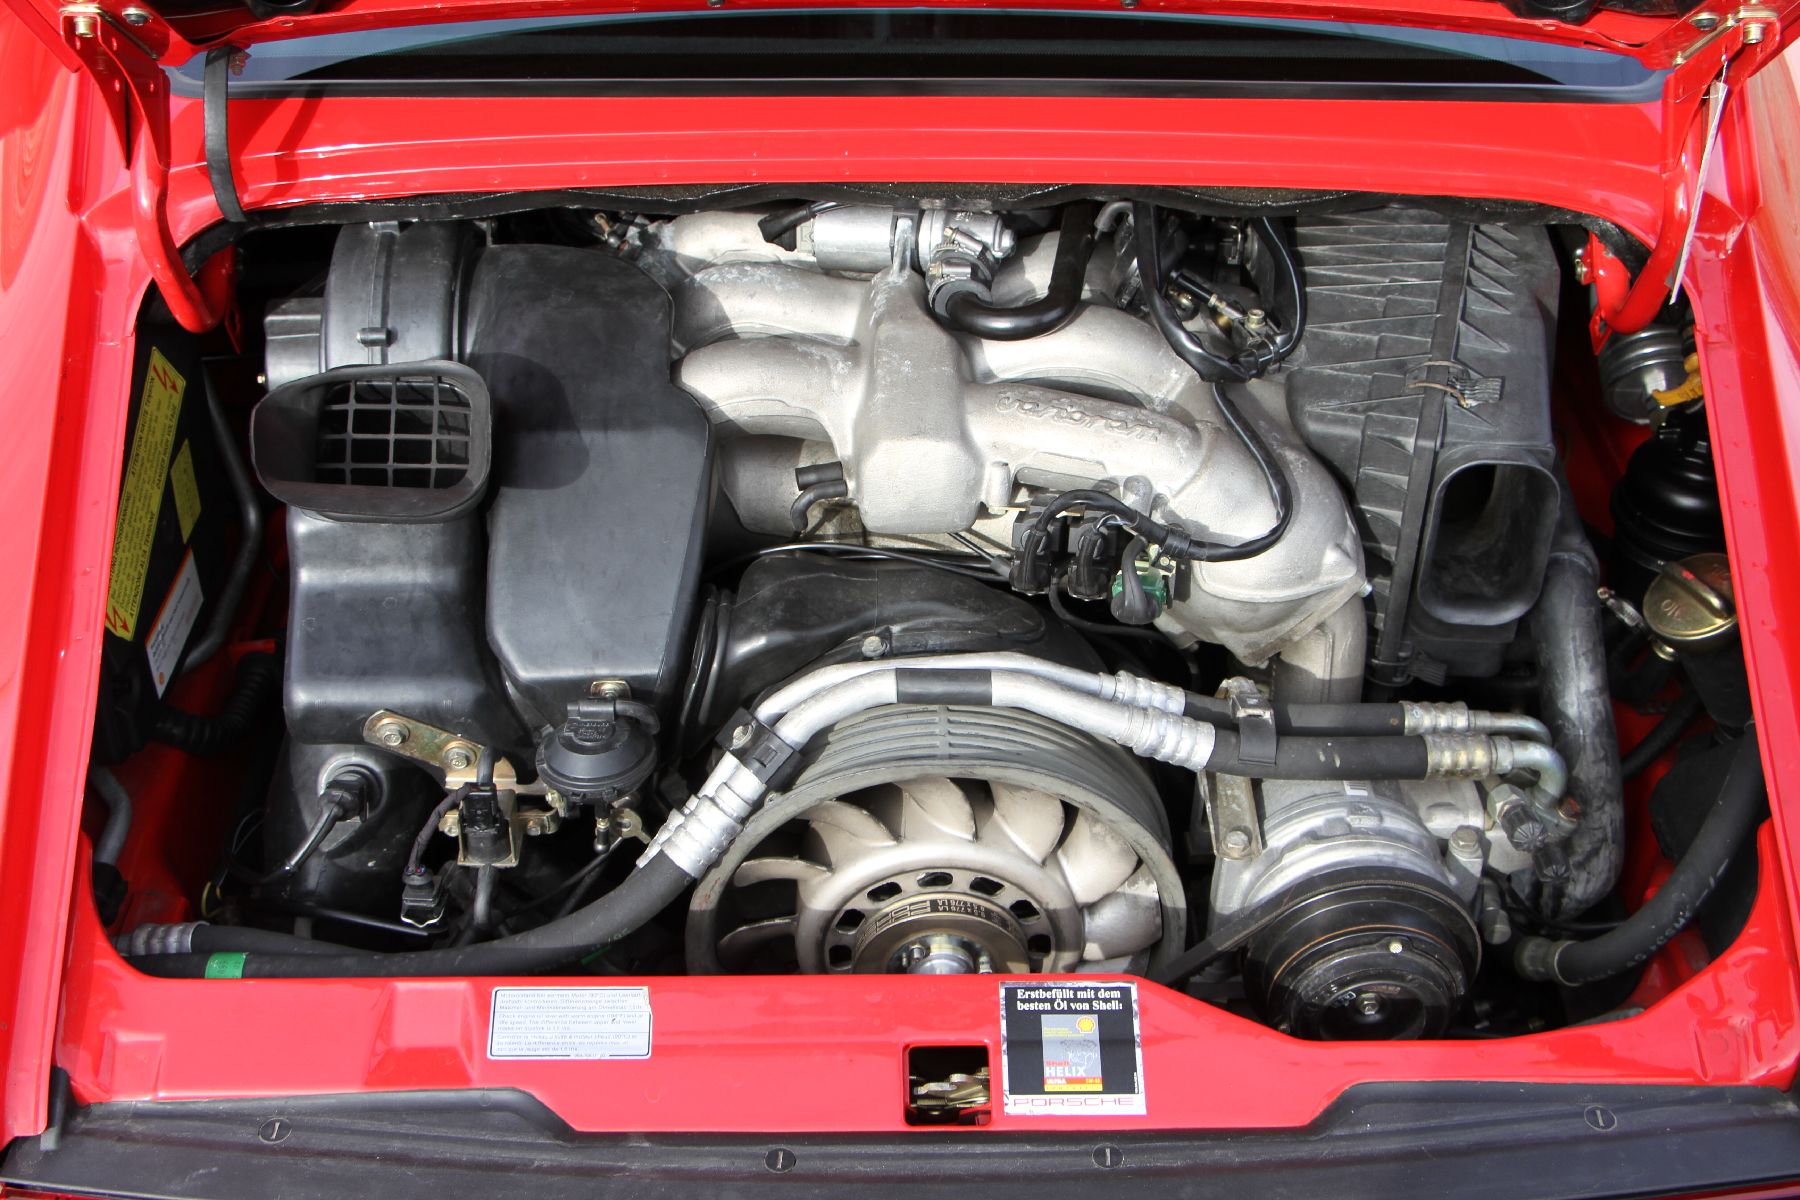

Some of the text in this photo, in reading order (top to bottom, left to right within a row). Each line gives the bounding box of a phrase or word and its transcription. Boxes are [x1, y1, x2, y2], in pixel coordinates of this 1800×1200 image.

[132, 434, 143, 477] ATTENTION
[1017, 989, 1120, 999] Erstbefüllt mit dem
[1017, 1000, 1051, 1010] besten
[1054, 999, 1067, 1010] Öl
[1046, 1066, 1085, 1076] HELIX
[1014, 1098, 1134, 1106] PORSCHE
